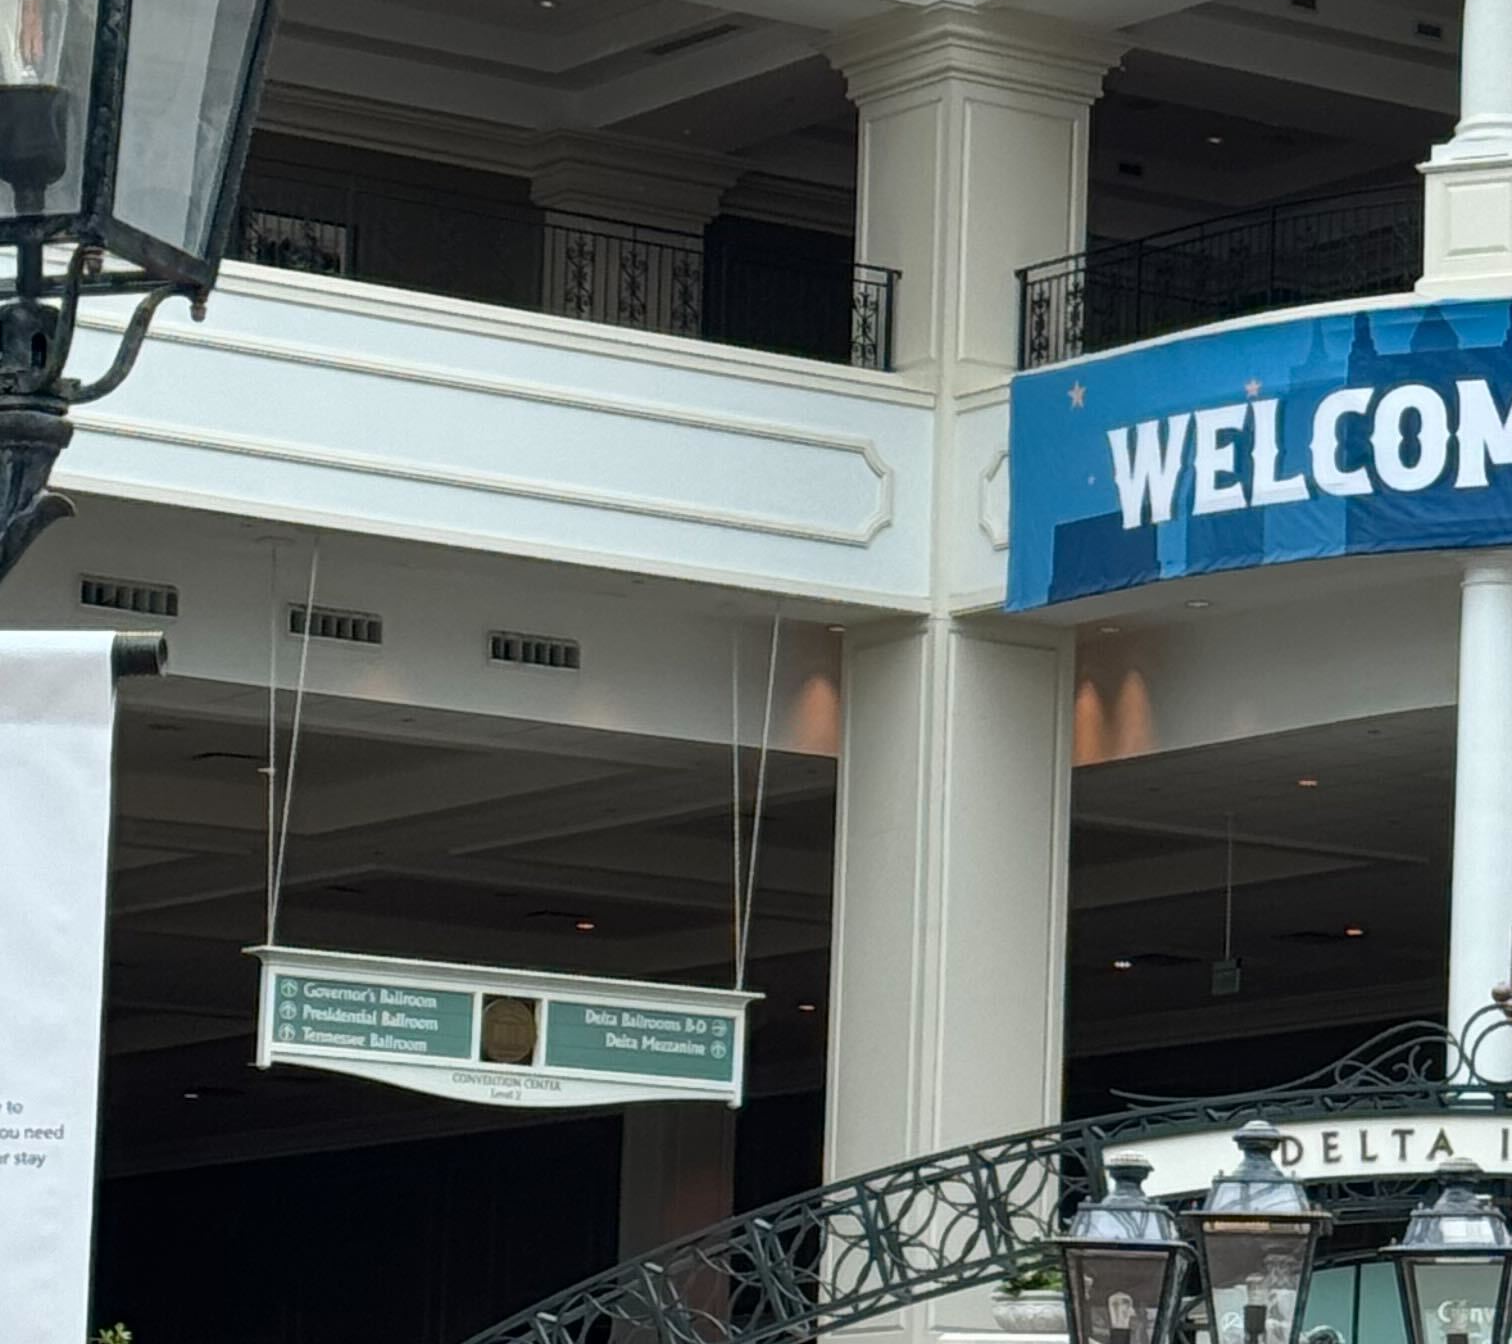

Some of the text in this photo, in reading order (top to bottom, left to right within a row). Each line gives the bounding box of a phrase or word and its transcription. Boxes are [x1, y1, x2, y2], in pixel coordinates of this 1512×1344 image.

[303, 982, 437, 1009] Governor's Ballroom
[302, 1004, 438, 1031] Presidential Ballroom
[585, 1009, 618, 1026] Delta
[621, 1012, 682, 1032] Ballrooms
[301, 1026, 428, 1052] Tennessee Ballroom
[605, 1033, 706, 1056] Delta Mezzanine
[451, 1072, 522, 1089] CONVENTION
[6, 1100, 24, 1115] to
[0, 1123, 64, 1140] ou need
[1279, 1128, 1454, 1167] DELTA
[14, 1151, 46, 1169] stay
